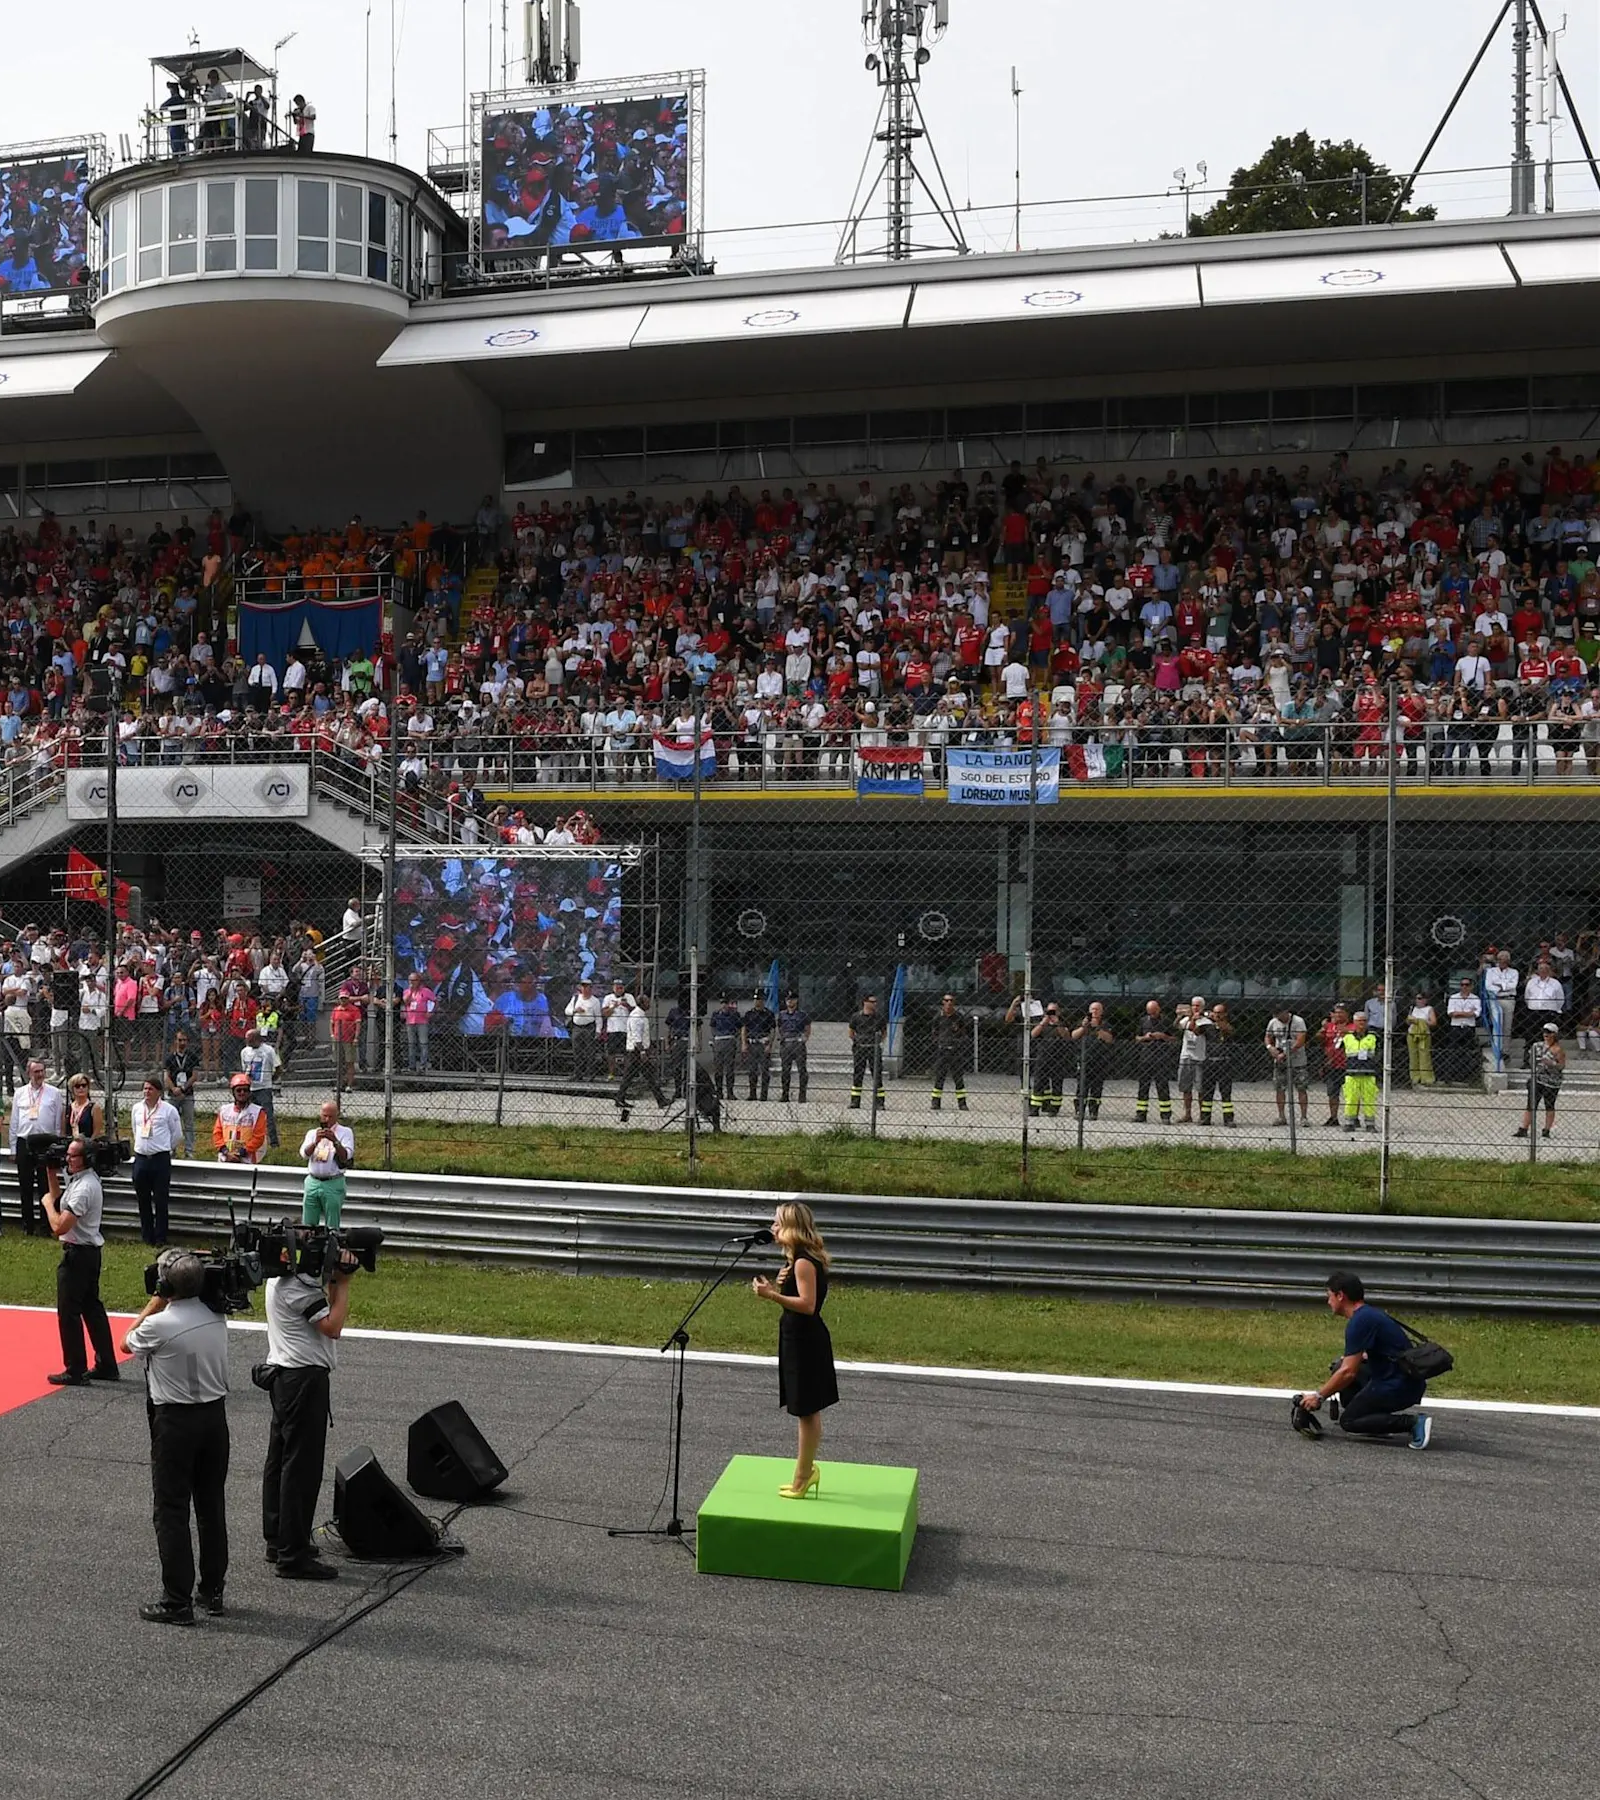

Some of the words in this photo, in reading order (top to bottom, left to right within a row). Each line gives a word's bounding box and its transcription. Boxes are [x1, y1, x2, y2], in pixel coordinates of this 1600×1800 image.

[965, 754, 983, 765] LA
[994, 754, 1043, 766] BANDA
[961, 772, 984, 783] SGO.
[985, 774, 1005, 784] DEL
[1008, 772, 1050, 784] ESTRO
[89, 786, 108, 799] AC
[176, 784, 199, 797] ACI
[267, 783, 290, 796] ACI
[961, 788, 1005, 800] LORENZO
[1009, 789, 1039, 801] MUSI
